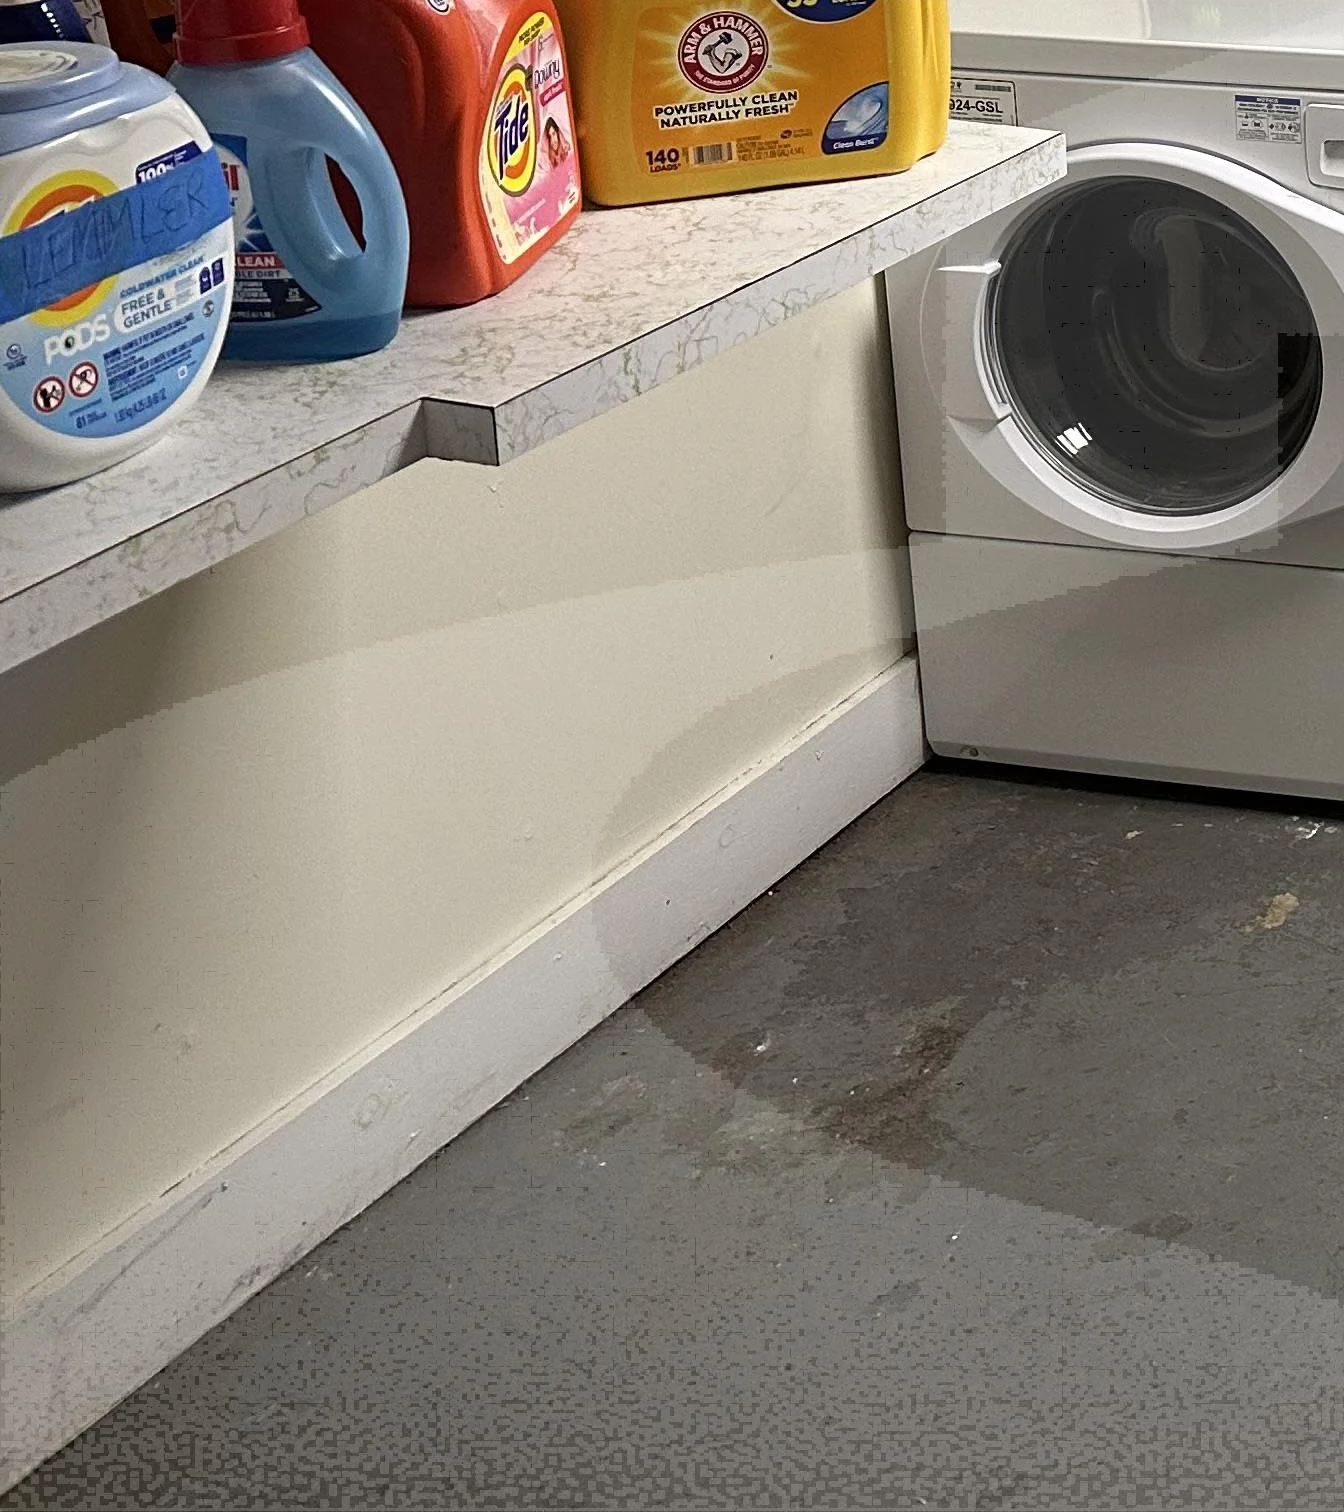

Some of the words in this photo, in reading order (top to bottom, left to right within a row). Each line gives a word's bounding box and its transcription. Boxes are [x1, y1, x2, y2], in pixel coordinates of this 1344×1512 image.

[683, 31, 703, 64] ARM
[698, 23, 712, 35] &
[712, 16, 764, 56] HAMMER
[534, 59, 560, 89] Downy
[655, 95, 748, 117] POWERFULLY
[751, 89, 798, 105] CLEAN
[660, 108, 741, 129] NATURALLY
[495, 99, 530, 181] Tide
[833, 140, 853, 150] Clean
[645, 147, 680, 165] 140
[120, 269, 176, 299] COLDWATER
[121, 294, 155, 315] FREE
[157, 289, 165, 300] &
[123, 299, 172, 330] GENTLE
[44, 314, 111, 365] PODS
